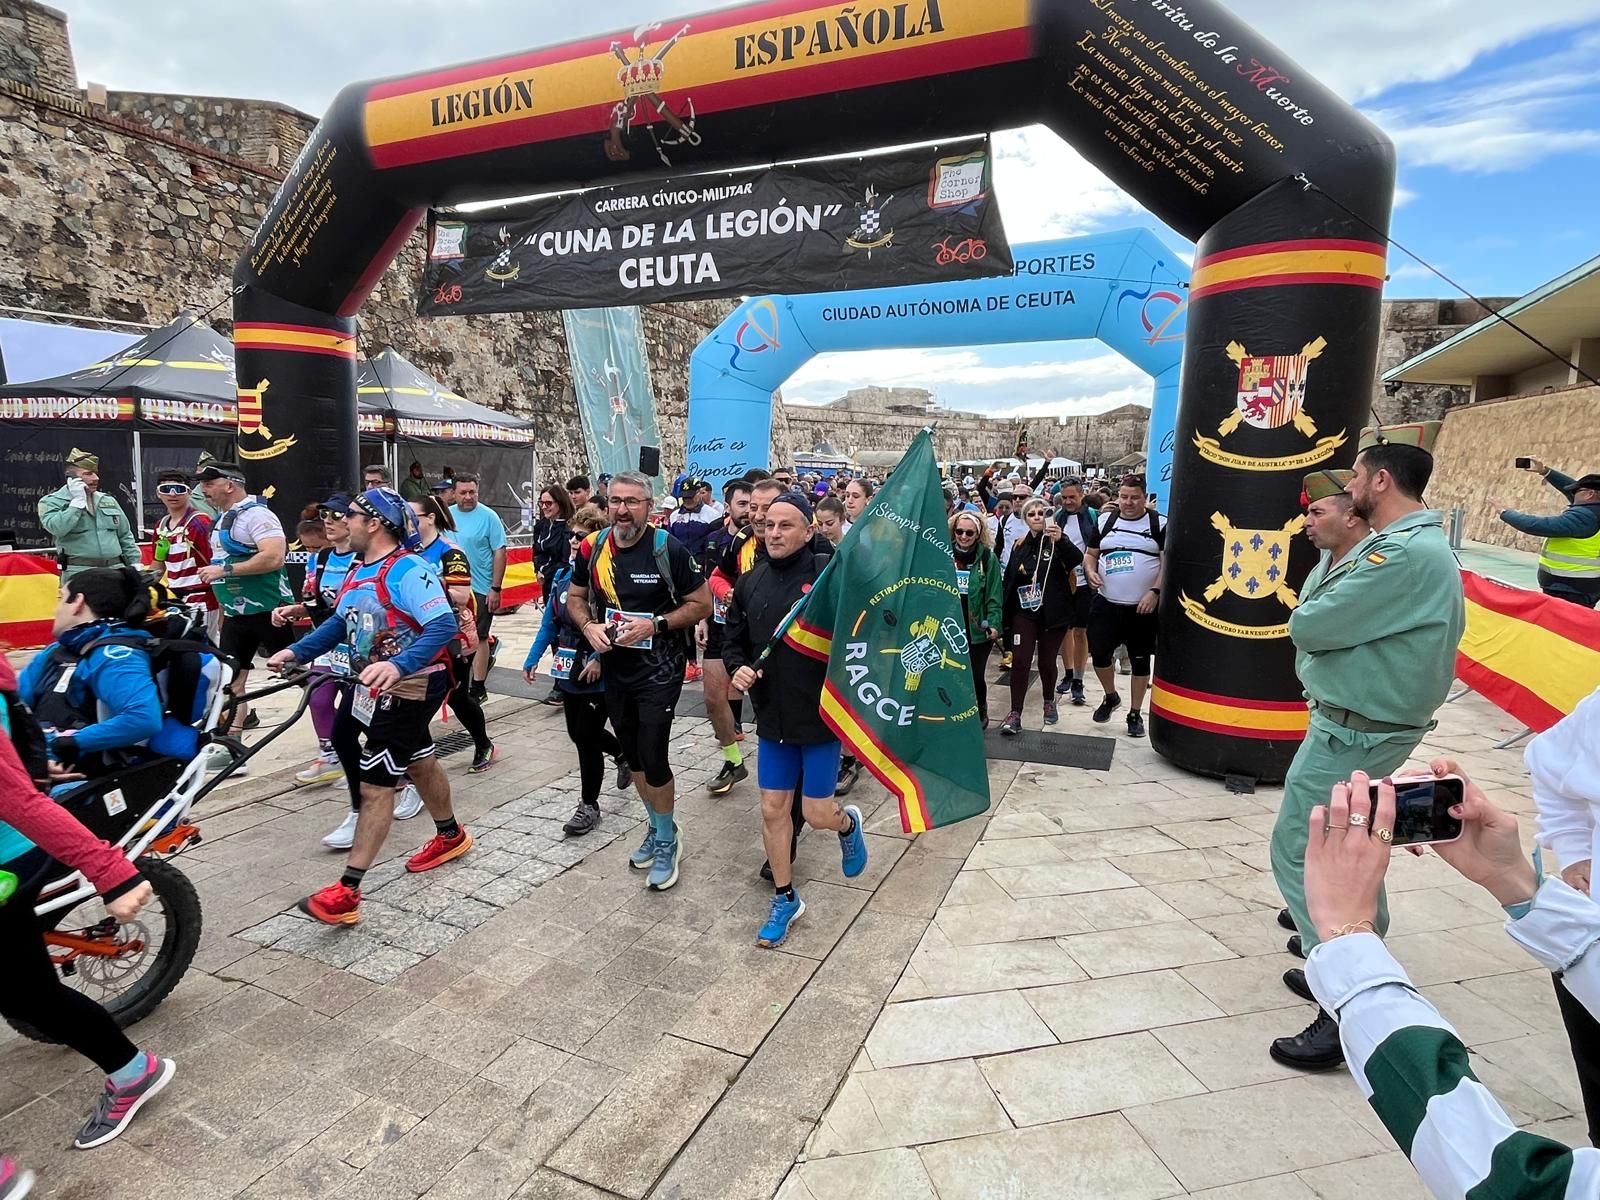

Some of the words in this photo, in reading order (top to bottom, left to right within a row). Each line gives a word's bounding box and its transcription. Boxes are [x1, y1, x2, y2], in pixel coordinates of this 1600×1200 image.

[431, 77, 534, 126] LEGIÓN
[734, 0, 945, 70] ESPAÑOLA
[1101, 25, 1130, 48] No
[1120, 46, 1132, 57] se
[1131, 55, 1163, 81] muere
[1161, 80, 1183, 98] más
[1177, 95, 1202, 113] que
[1200, 111, 1223, 131] una
[1105, 8, 1134, 32] morir
[1133, 30, 1148, 43] en
[1146, 41, 1166, 51] el
[1157, 48, 1198, 82] combate
[1195, 78, 1210, 91] es
[1207, 91, 1228, 100] el
[1218, 98, 1253, 125] mayor
[1193, 31, 1220, 48] de
[1214, 46, 1238, 64] la
[1236, 57, 1314, 126] Muerte
[1076, 29, 1096, 54] La
[1095, 50, 1129, 81] muerte
[1127, 75, 1153, 101] llega
[1151, 99, 1170, 114] sin
[1168, 110, 1195, 135] dolor
[1187, 133, 1205, 145] y
[1202, 140, 1223, 150] el
[1213, 149, 1244, 173] morir
[1076, 64, 1091, 76] no
[1090, 73, 1103, 85] es
[1101, 82, 1120, 99] tan
[1119, 94, 1159, 130] horrible
[1156, 128, 1181, 149] como
[1067, 71, 1084, 94] Lo
[1084, 91, 1104, 109] más
[1102, 105, 1142, 140] horrible
[1140, 139, 1153, 149] es
[1151, 146, 1176, 168] vivir
[1175, 168, 1209, 195] siendo
[1104, 129, 1119, 142] un
[594, 195, 649, 213] CARRERA
[652, 182, 753, 207] CÍVICO-MILITAR
[622, 224, 655, 250] DE
[662, 219, 697, 244] LA
[618, 252, 721, 289] CEUTA
[1015, 252, 1096, 276] PORTES
[822, 305, 881, 322] CIUDAD
[886, 298, 982, 318] AUTÓNOMA
[987, 295, 1009, 312] DE
[1015, 289, 1075, 309] CEUTA
[27, 397, 119, 420] DEPORTIVO
[140, 398, 224, 423] TERCIO
[398, 417, 443, 438] TERCIO
[730, 440, 747, 451] es
[1230, 458, 1247, 467] JUAN
[1305, 455, 1313, 463] LA
[688, 461, 747, 481] Deporte
[868, 502, 920, 532] ¡Siempre
[1113, 556, 1131, 566] 3853
[869, 576, 917, 606] RETIRADOS
[845, 641, 915, 726] RAGCE
